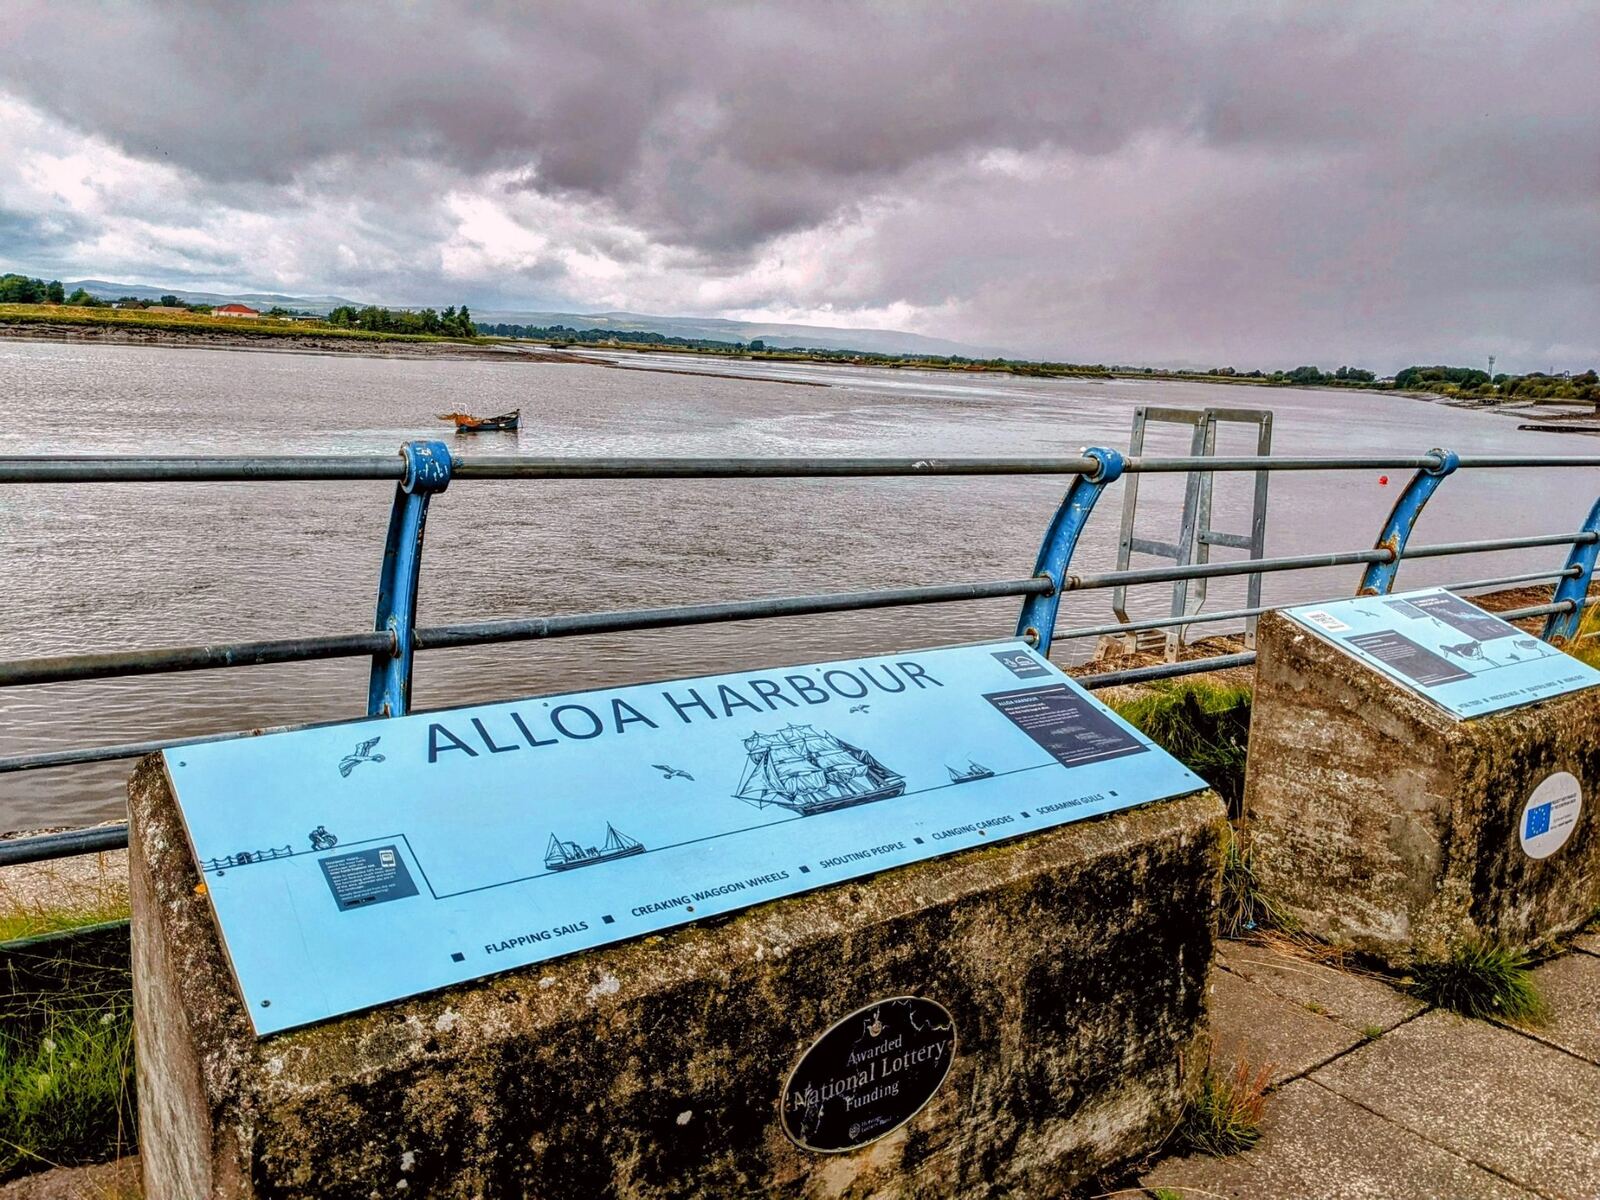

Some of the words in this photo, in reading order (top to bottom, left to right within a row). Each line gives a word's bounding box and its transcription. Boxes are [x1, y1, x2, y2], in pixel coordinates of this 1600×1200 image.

[427, 698, 659, 763] ALLOA
[661, 661, 944, 724] HARBOUR
[1036, 798, 1082, 815] SCREAMING
[1080, 793, 1105, 807] GULLS
[931, 823, 977, 841] CLANGING
[976, 814, 1015, 832] CARGOES
[819, 849, 873, 870] SHOUTING
[870, 840, 907, 857] PEOPLE
[631, 895, 692, 918] CREAKING
[690, 880, 746, 902] WAGGON
[744, 870, 790, 888] WHEELS
[484, 929, 552, 955] FLAPPING
[553, 920, 589, 938] SAILS
[846, 1034, 903, 1067] Awarded
[792, 1062, 875, 1111] National
[881, 1039, 947, 1078] Lottery
[845, 1080, 900, 1112] Funding
